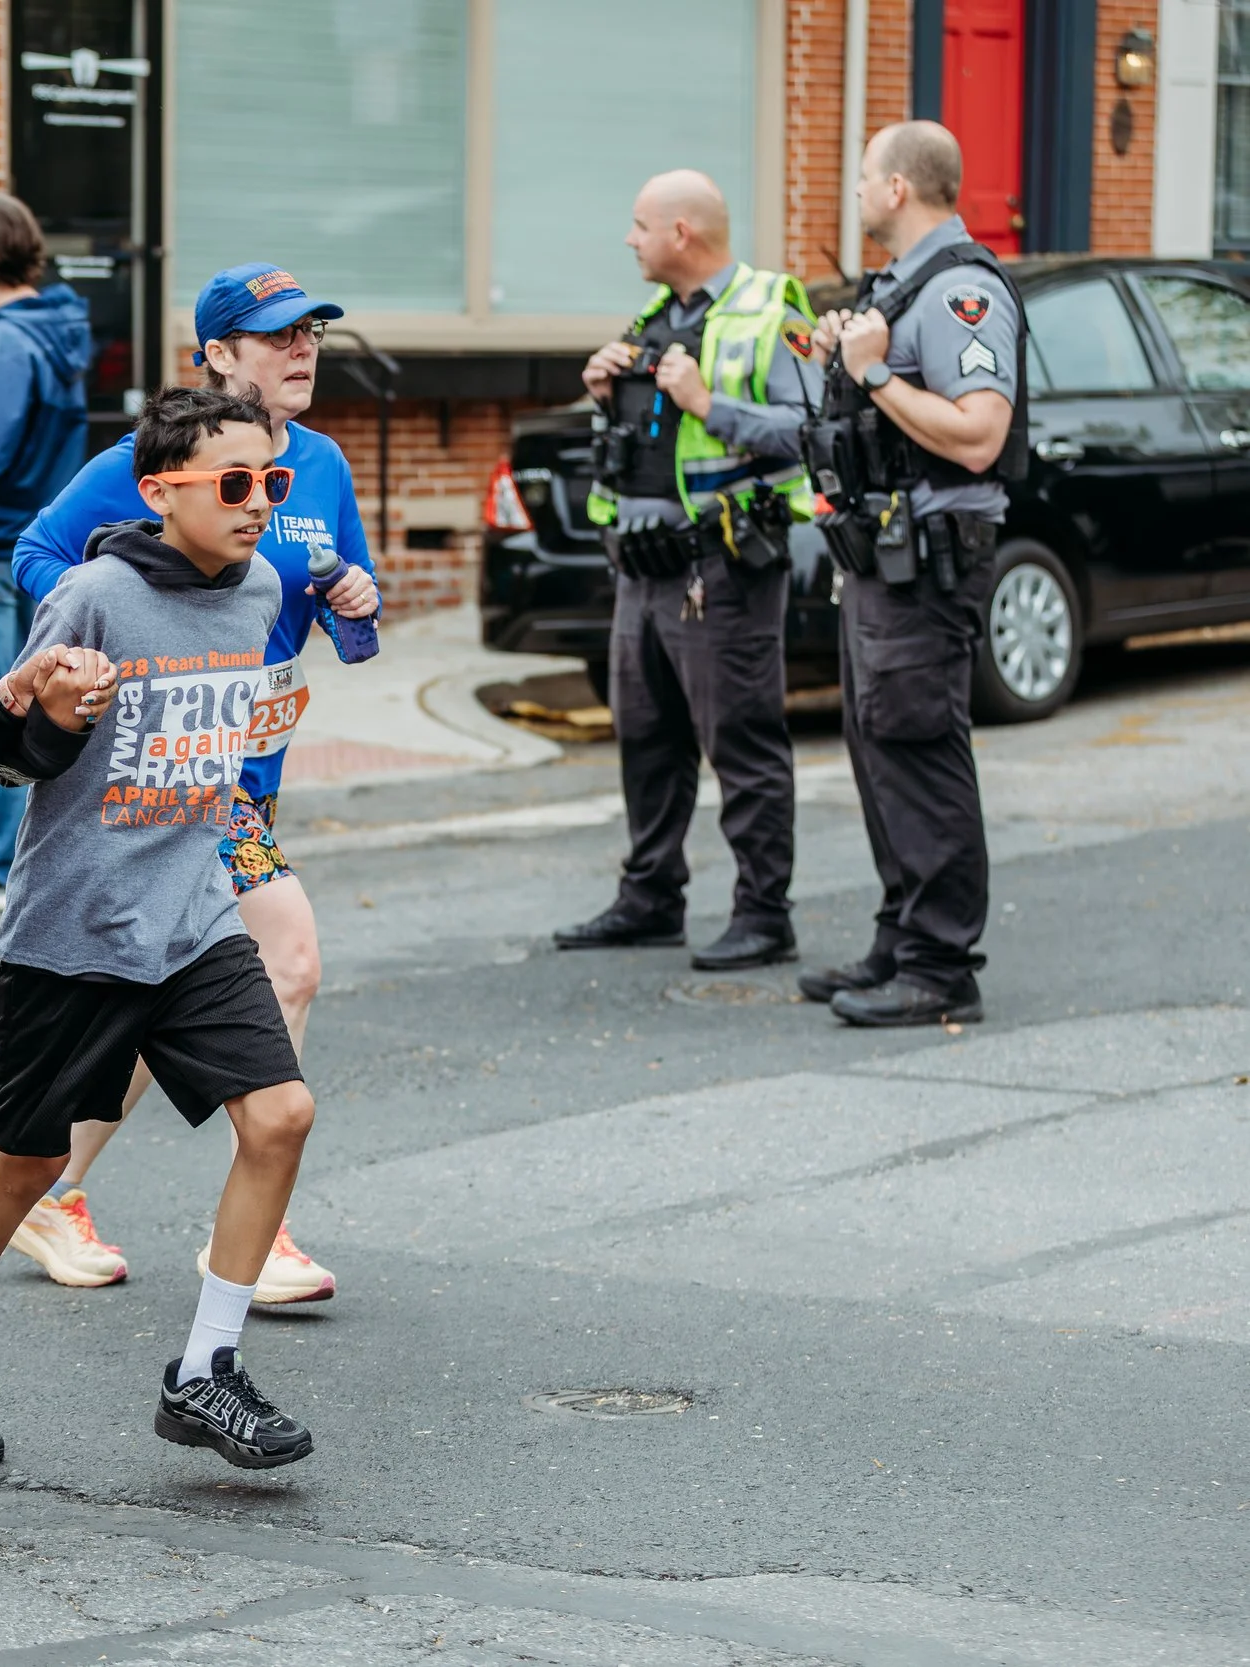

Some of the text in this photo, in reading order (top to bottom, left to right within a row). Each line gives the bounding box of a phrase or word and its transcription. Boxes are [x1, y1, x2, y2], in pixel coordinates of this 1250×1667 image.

[281, 515, 315, 530] TEAM
[314, 518, 326, 531] IN
[283, 529, 333, 546] TRAINING
[120, 658, 149, 679] 28
[154, 655, 204, 673] Years
[250, 696, 297, 735] 238
[107, 681, 144, 782] ywca
[102, 785, 180, 807] APRIL
[186, 785, 222, 806] 25,
